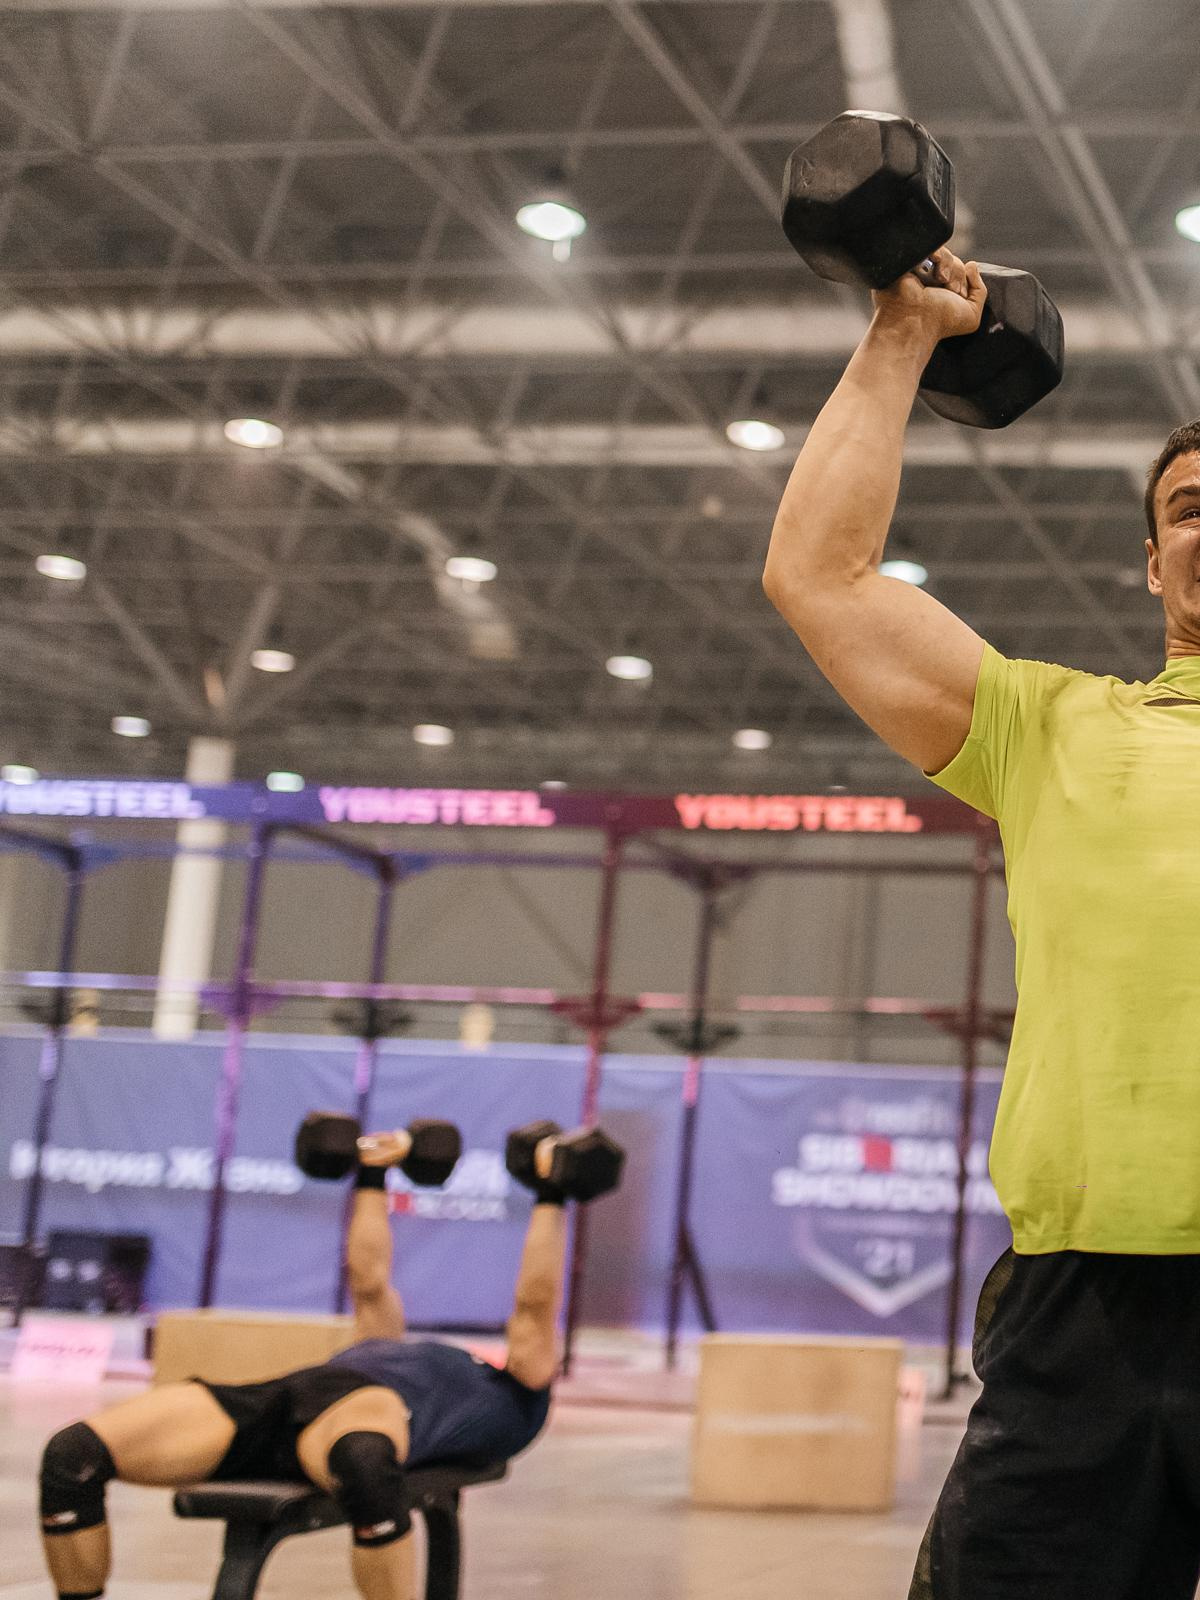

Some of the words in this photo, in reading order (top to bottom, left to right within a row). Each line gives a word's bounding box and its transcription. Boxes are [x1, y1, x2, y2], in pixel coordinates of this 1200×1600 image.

[0, 779, 206, 819] OUSTEEL
[319, 786, 556, 827] YOUSTEEL
[675, 794, 923, 832] YOUSTEEL
